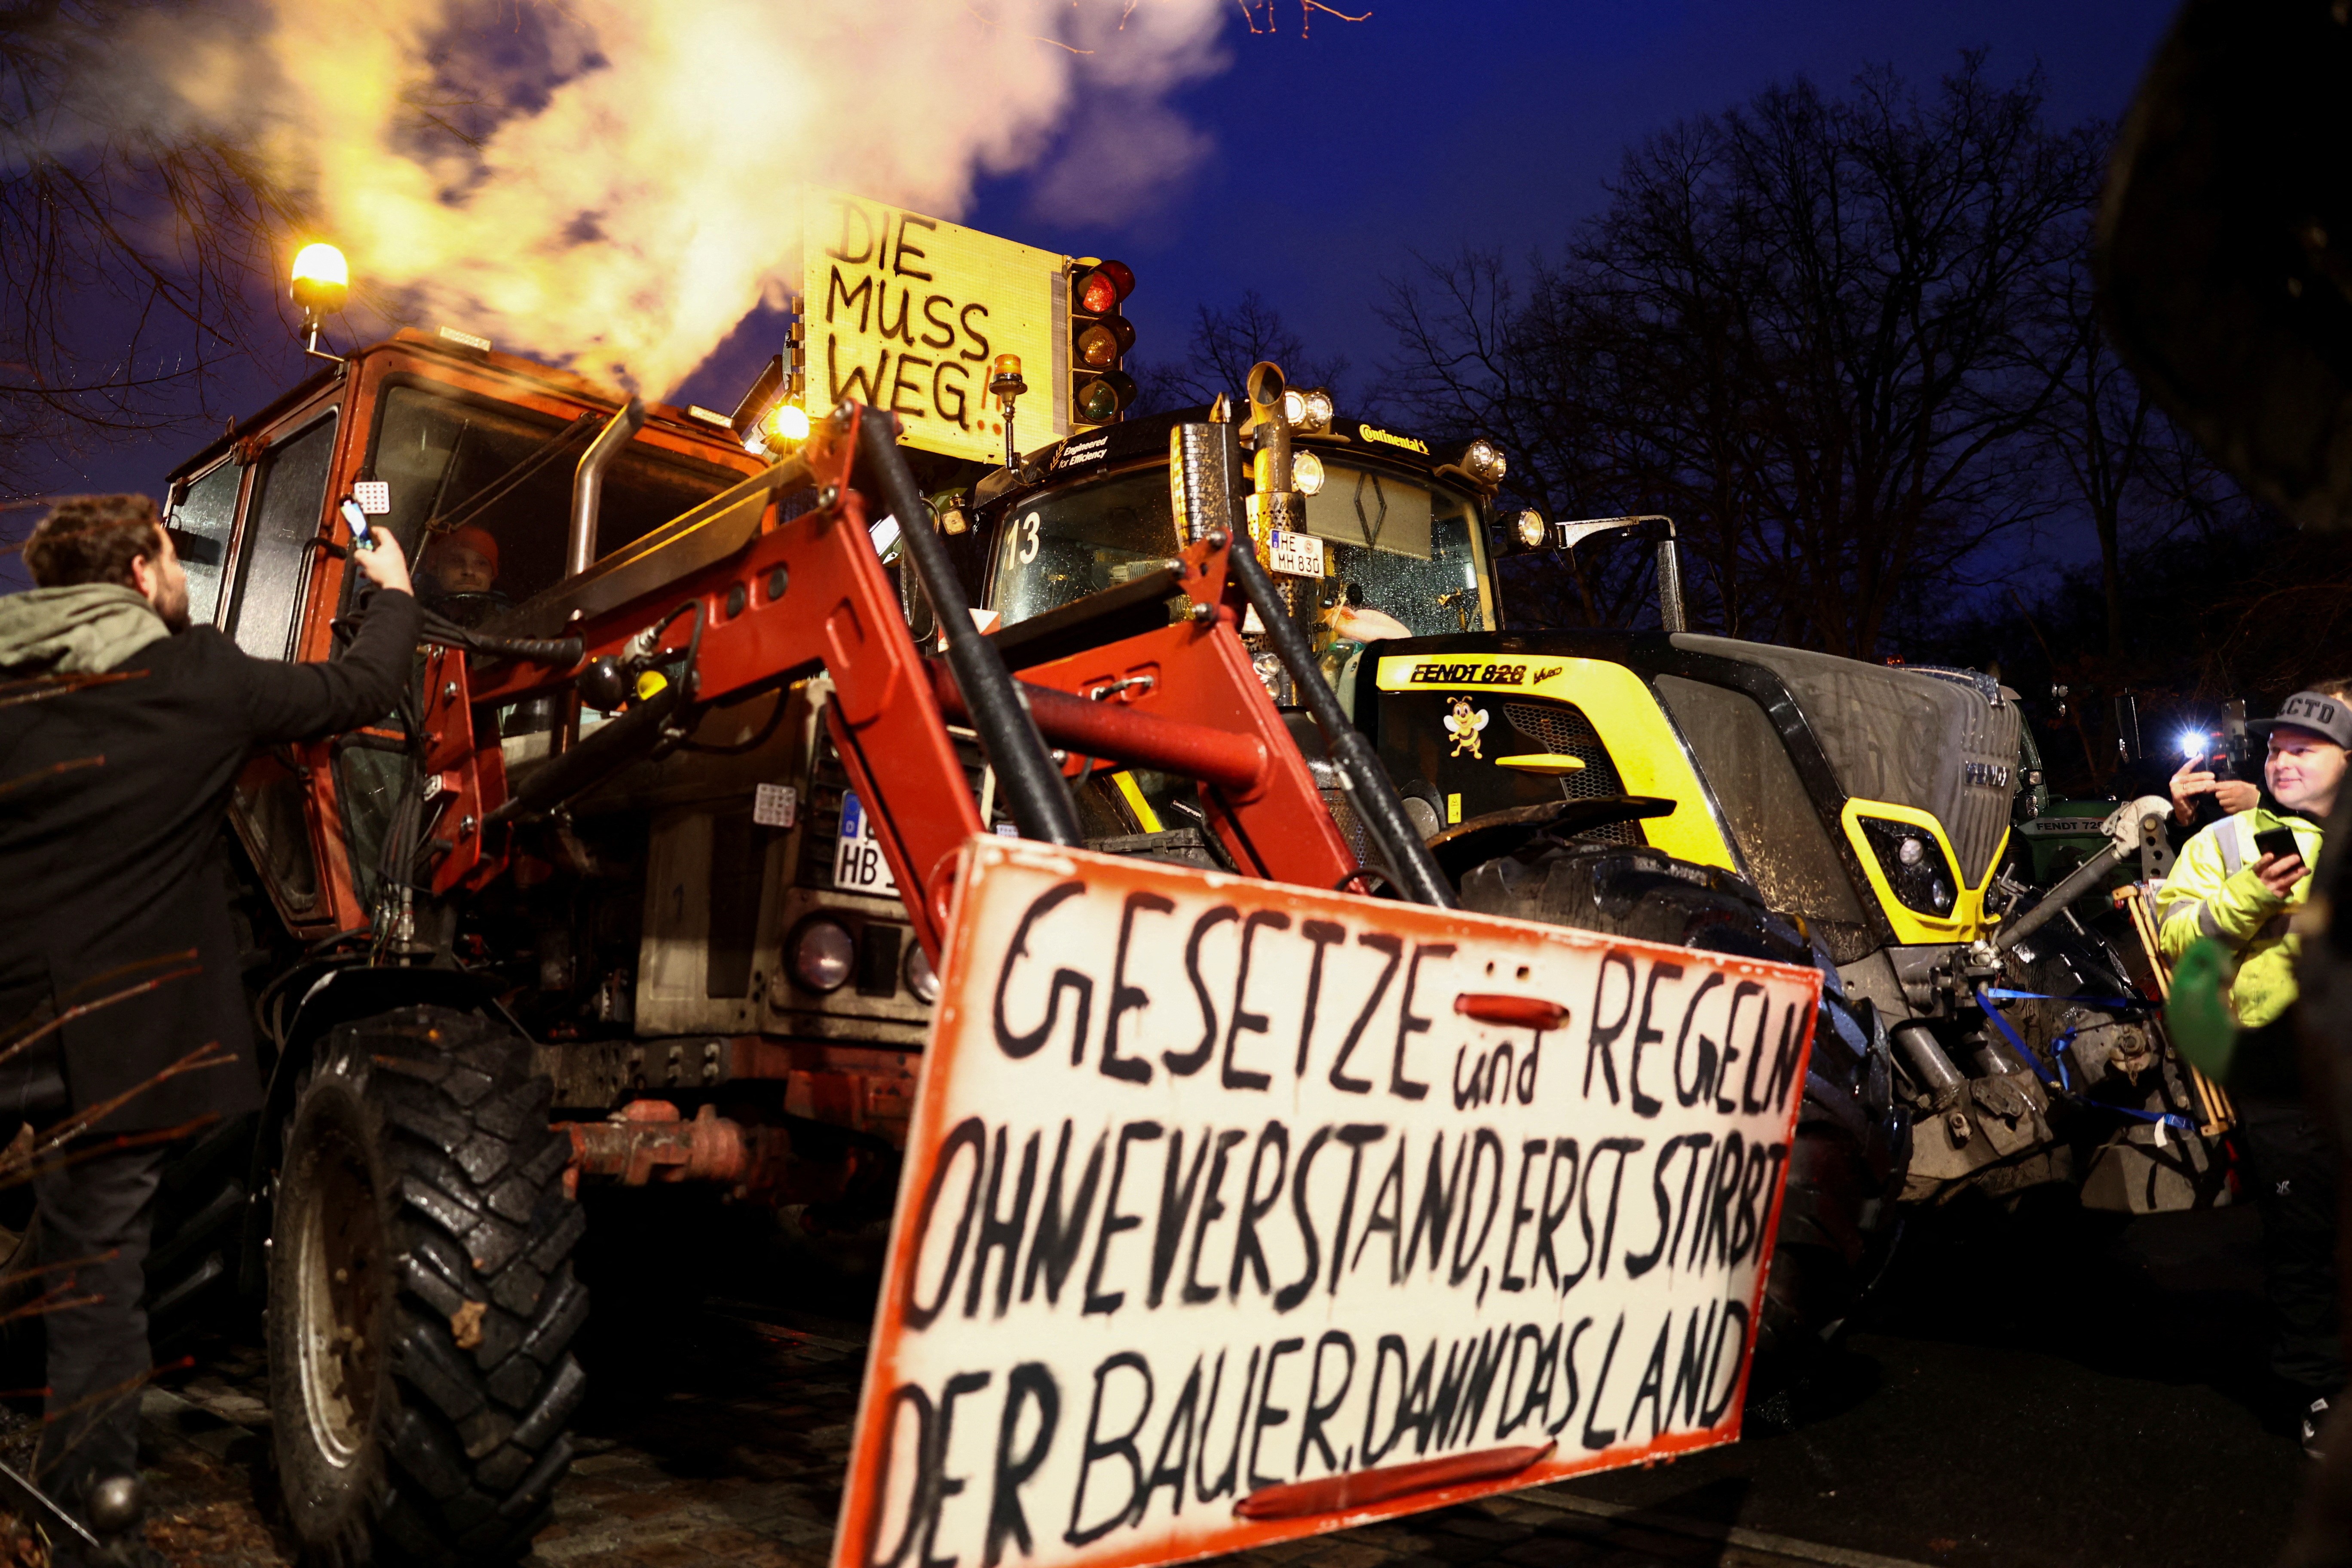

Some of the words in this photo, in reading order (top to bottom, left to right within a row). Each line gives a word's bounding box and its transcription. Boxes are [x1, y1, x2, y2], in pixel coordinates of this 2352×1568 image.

[825, 198, 936, 282] DIE
[826, 264, 989, 361] MUSS
[1063, 436, 1108, 456] Engineered
[1360, 424, 1421, 453] Continental
[1059, 459, 1069, 469] for
[1069, 449, 1108, 466] Efficiency
[1007, 511, 1041, 571] 13
[1281, 534, 1296, 552] HE
[1278, 553, 1294, 570] MH
[1410, 664, 1482, 683] FENDT
[1482, 664, 1527, 685] 828
[1966, 763, 2010, 787] FENDT
[2037, 822, 2077, 830] FENDT
[840, 844, 878, 885] HB
[992, 881, 1458, 1101] GESETZE
[1582, 948, 1810, 1118] REGELN
[1625, 1130, 1791, 1280] STIRBT
[863, 1360, 1061, 1568] DER
[1582, 1298, 1749, 1450] LAND
